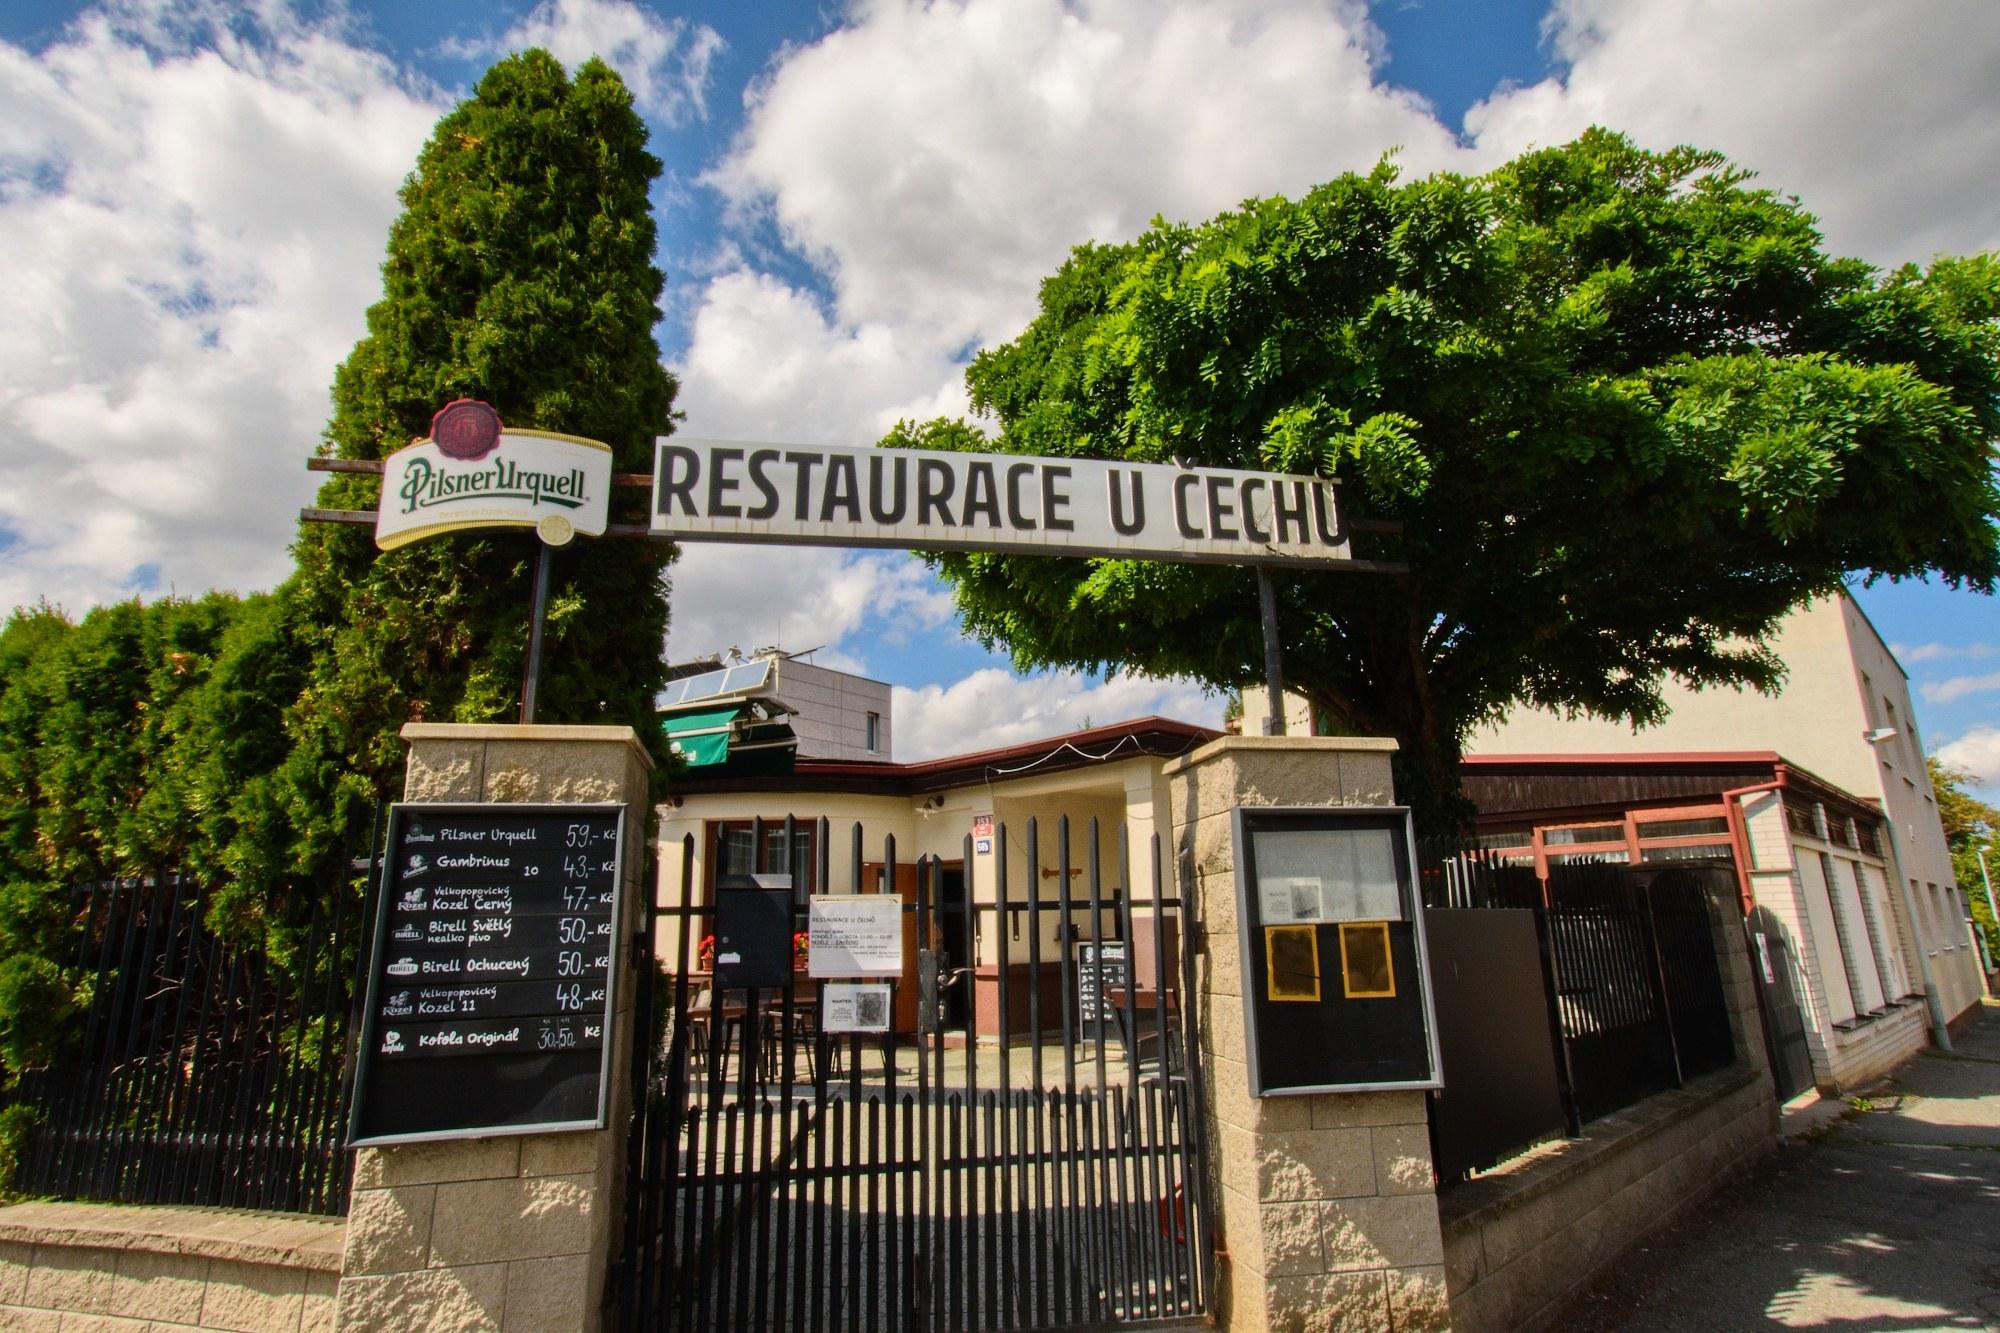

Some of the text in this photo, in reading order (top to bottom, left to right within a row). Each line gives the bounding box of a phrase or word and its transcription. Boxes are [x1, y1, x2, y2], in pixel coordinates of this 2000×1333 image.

[400, 456, 585, 514] Pilsner Urquell
[657, 445, 1075, 532] RESTAURACE
[1106, 469, 1146, 536] U
[440, 828, 486, 841] Pilsner
[491, 828, 537, 846] Urquell
[603, 830, 617, 840] Kč
[436, 853, 511, 868] Gambrinus
[523, 865, 539, 877] 10
[602, 861, 616, 872] Kč
[434, 886, 510, 899] Velkopopovický
[600, 892, 614, 903] Kč
[432, 895, 513, 914] Kozel Černý
[429, 920, 467, 934] Birell
[472, 918, 512, 938] Světlý
[597, 924, 611, 935] Kč
[427, 933, 491, 947] nealko pivo
[422, 959, 461, 973] Birell
[466, 956, 530, 976] Ochucený
[595, 956, 609, 968] Kč
[420, 986, 497, 1001] Velkopopovický
[591, 989, 605, 1001] Kč
[418, 1000, 476, 1014] Kozel 11
[419, 1031, 463, 1047] Kofola
[467, 1027, 520, 1047] Originál
[584, 1026, 601, 1038] Kč
